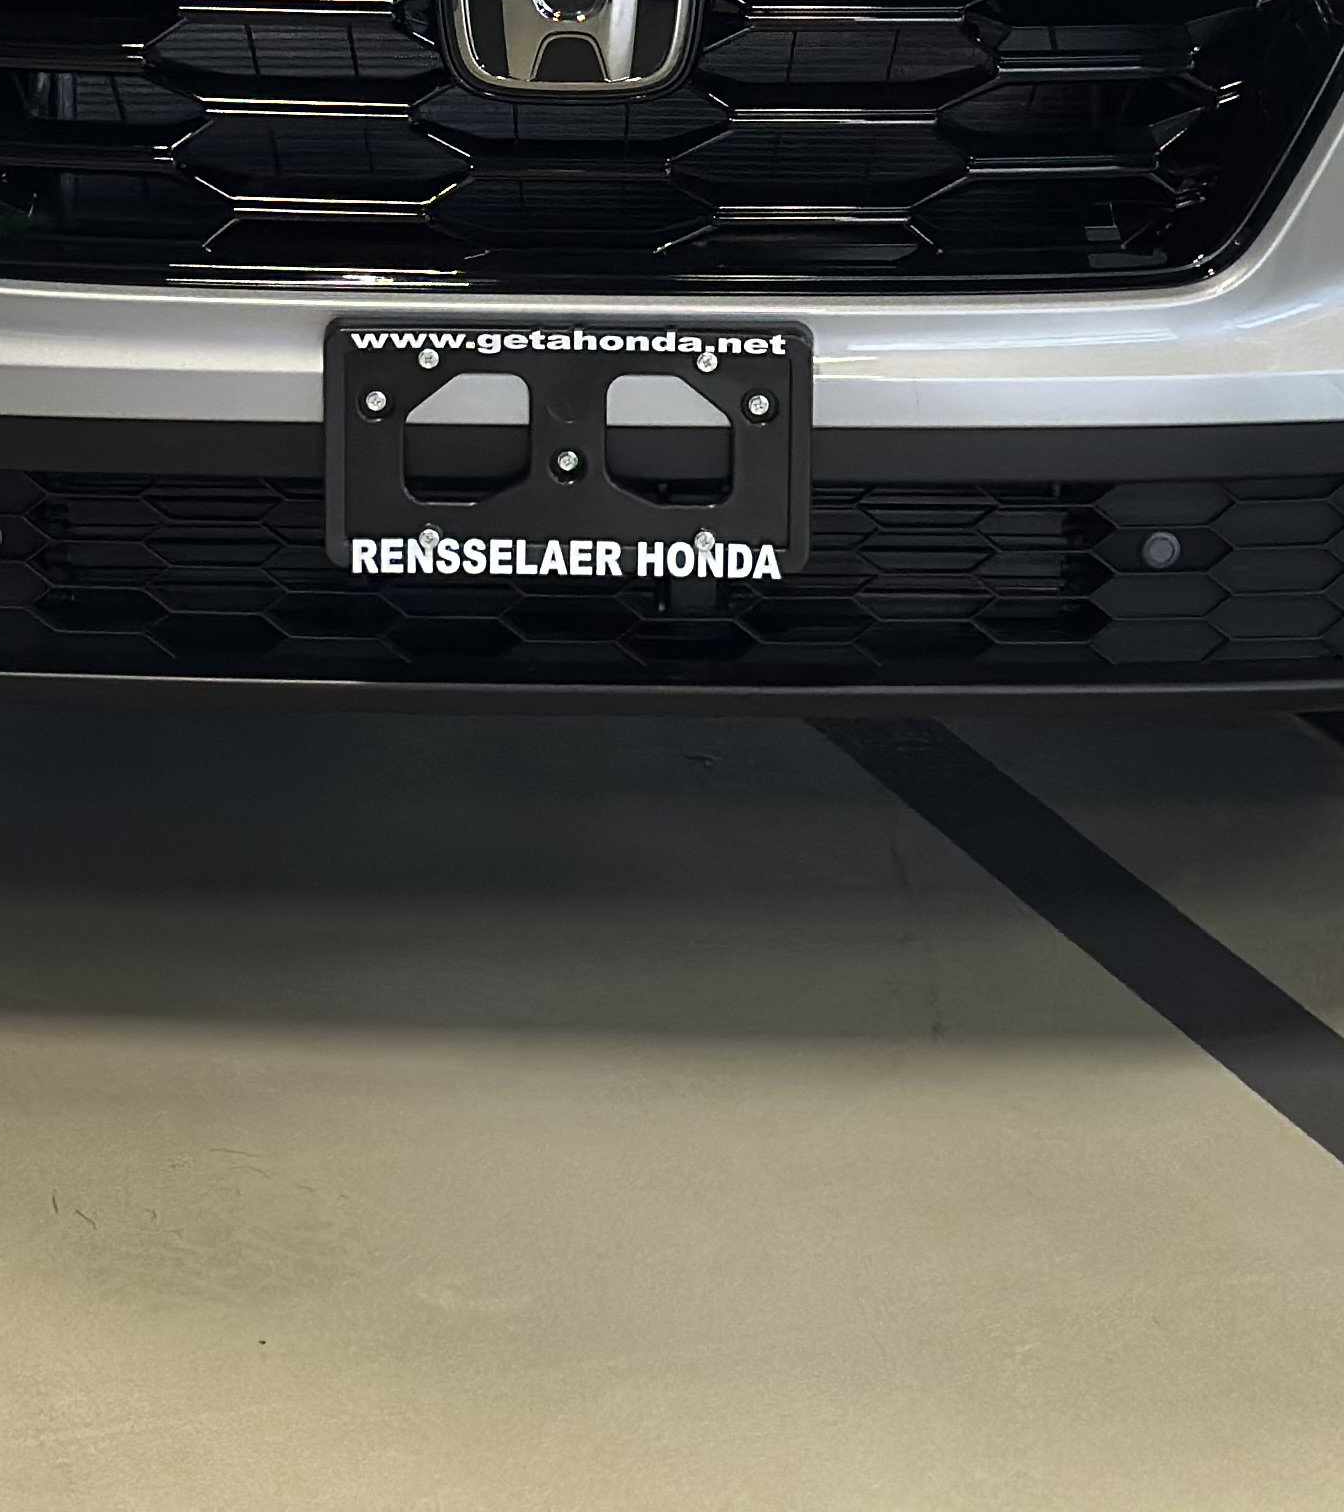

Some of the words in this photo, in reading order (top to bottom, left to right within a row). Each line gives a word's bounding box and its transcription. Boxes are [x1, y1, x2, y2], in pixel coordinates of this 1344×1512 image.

[351, 330, 786, 354] www.getahonda.net
[352, 538, 623, 576] RENSSELAER
[637, 541, 782, 580] HONDA
